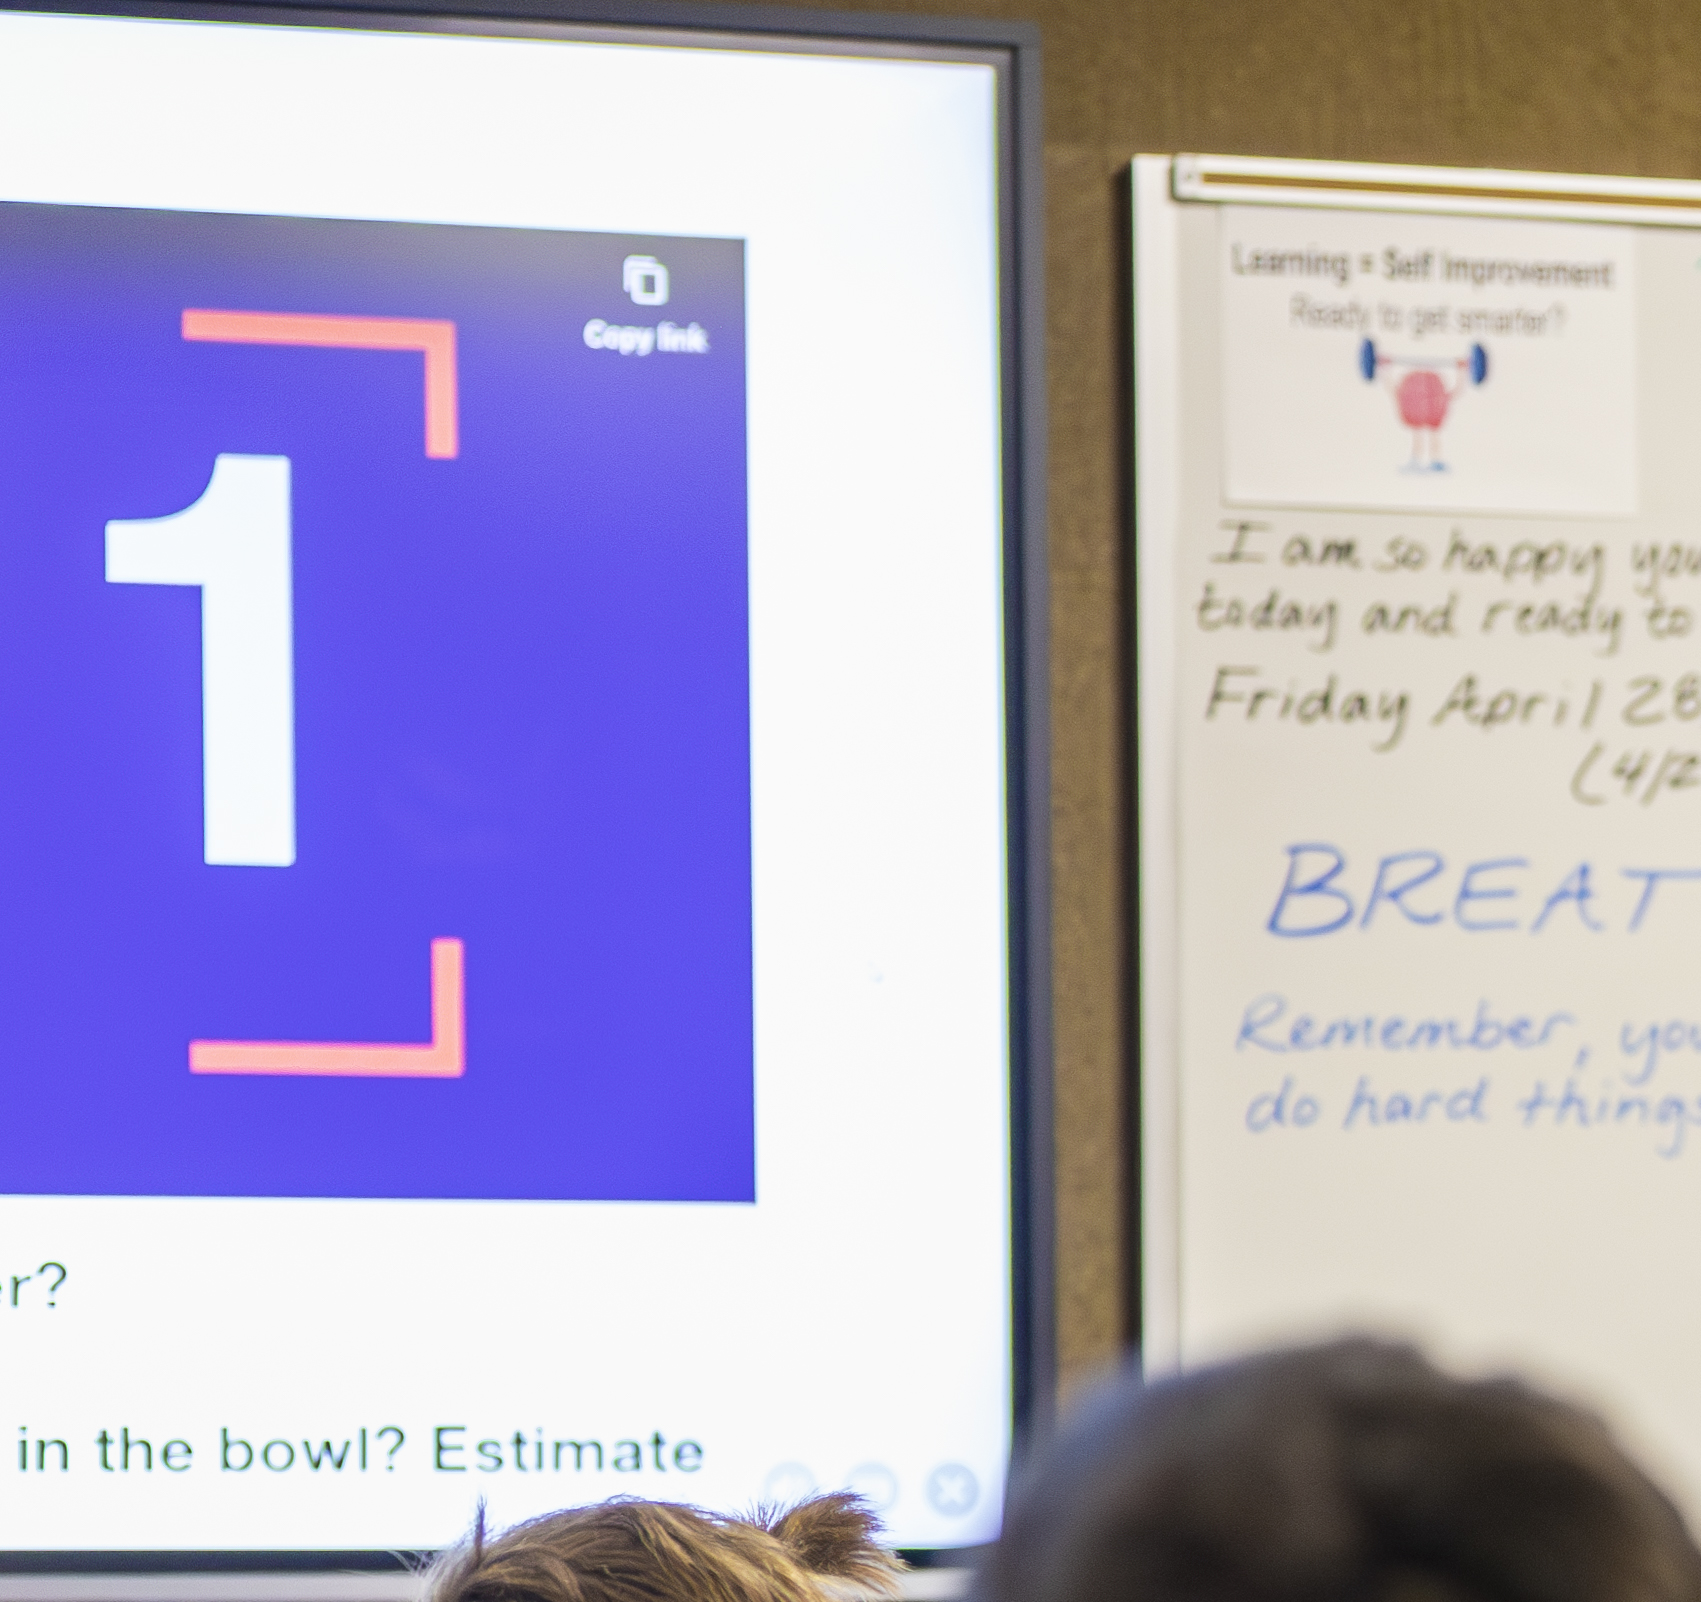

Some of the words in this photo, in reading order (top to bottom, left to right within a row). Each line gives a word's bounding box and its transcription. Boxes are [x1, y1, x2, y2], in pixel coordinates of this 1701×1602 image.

[1231, 243, 1349, 285] Learning
[1383, 246, 1434, 278] Self
[1442, 250, 1615, 289] Improvement
[583, 318, 654, 356] Copy
[657, 320, 711, 354] link
[1290, 295, 1368, 328] Ready
[1379, 302, 1401, 327] to
[1412, 302, 1449, 336] get
[1457, 302, 1567, 336] smarter?
[1210, 518, 1272, 564] I
[1281, 536, 1363, 572] am
[1373, 535, 1428, 573] so
[1441, 527, 1606, 598] happy
[1198, 583, 1338, 652] today
[1361, 594, 1457, 638] and
[1481, 594, 1624, 656] ready
[1647, 598, 1695, 641] to
[105, 452, 296, 866] 1
[1205, 665, 1412, 753] Friday
[1430, 673, 1605, 731] April
[1235, 992, 1590, 1070] Remember,
[1244, 1074, 1321, 1134] do
[1341, 1074, 1490, 1131] hard
[0, 1260, 67, 1307] r?
[18, 1425, 69, 1472] in
[95, 1426, 194, 1473] the
[220, 1425, 407, 1474] bowl?
[432, 1426, 705, 1474] Estimate
